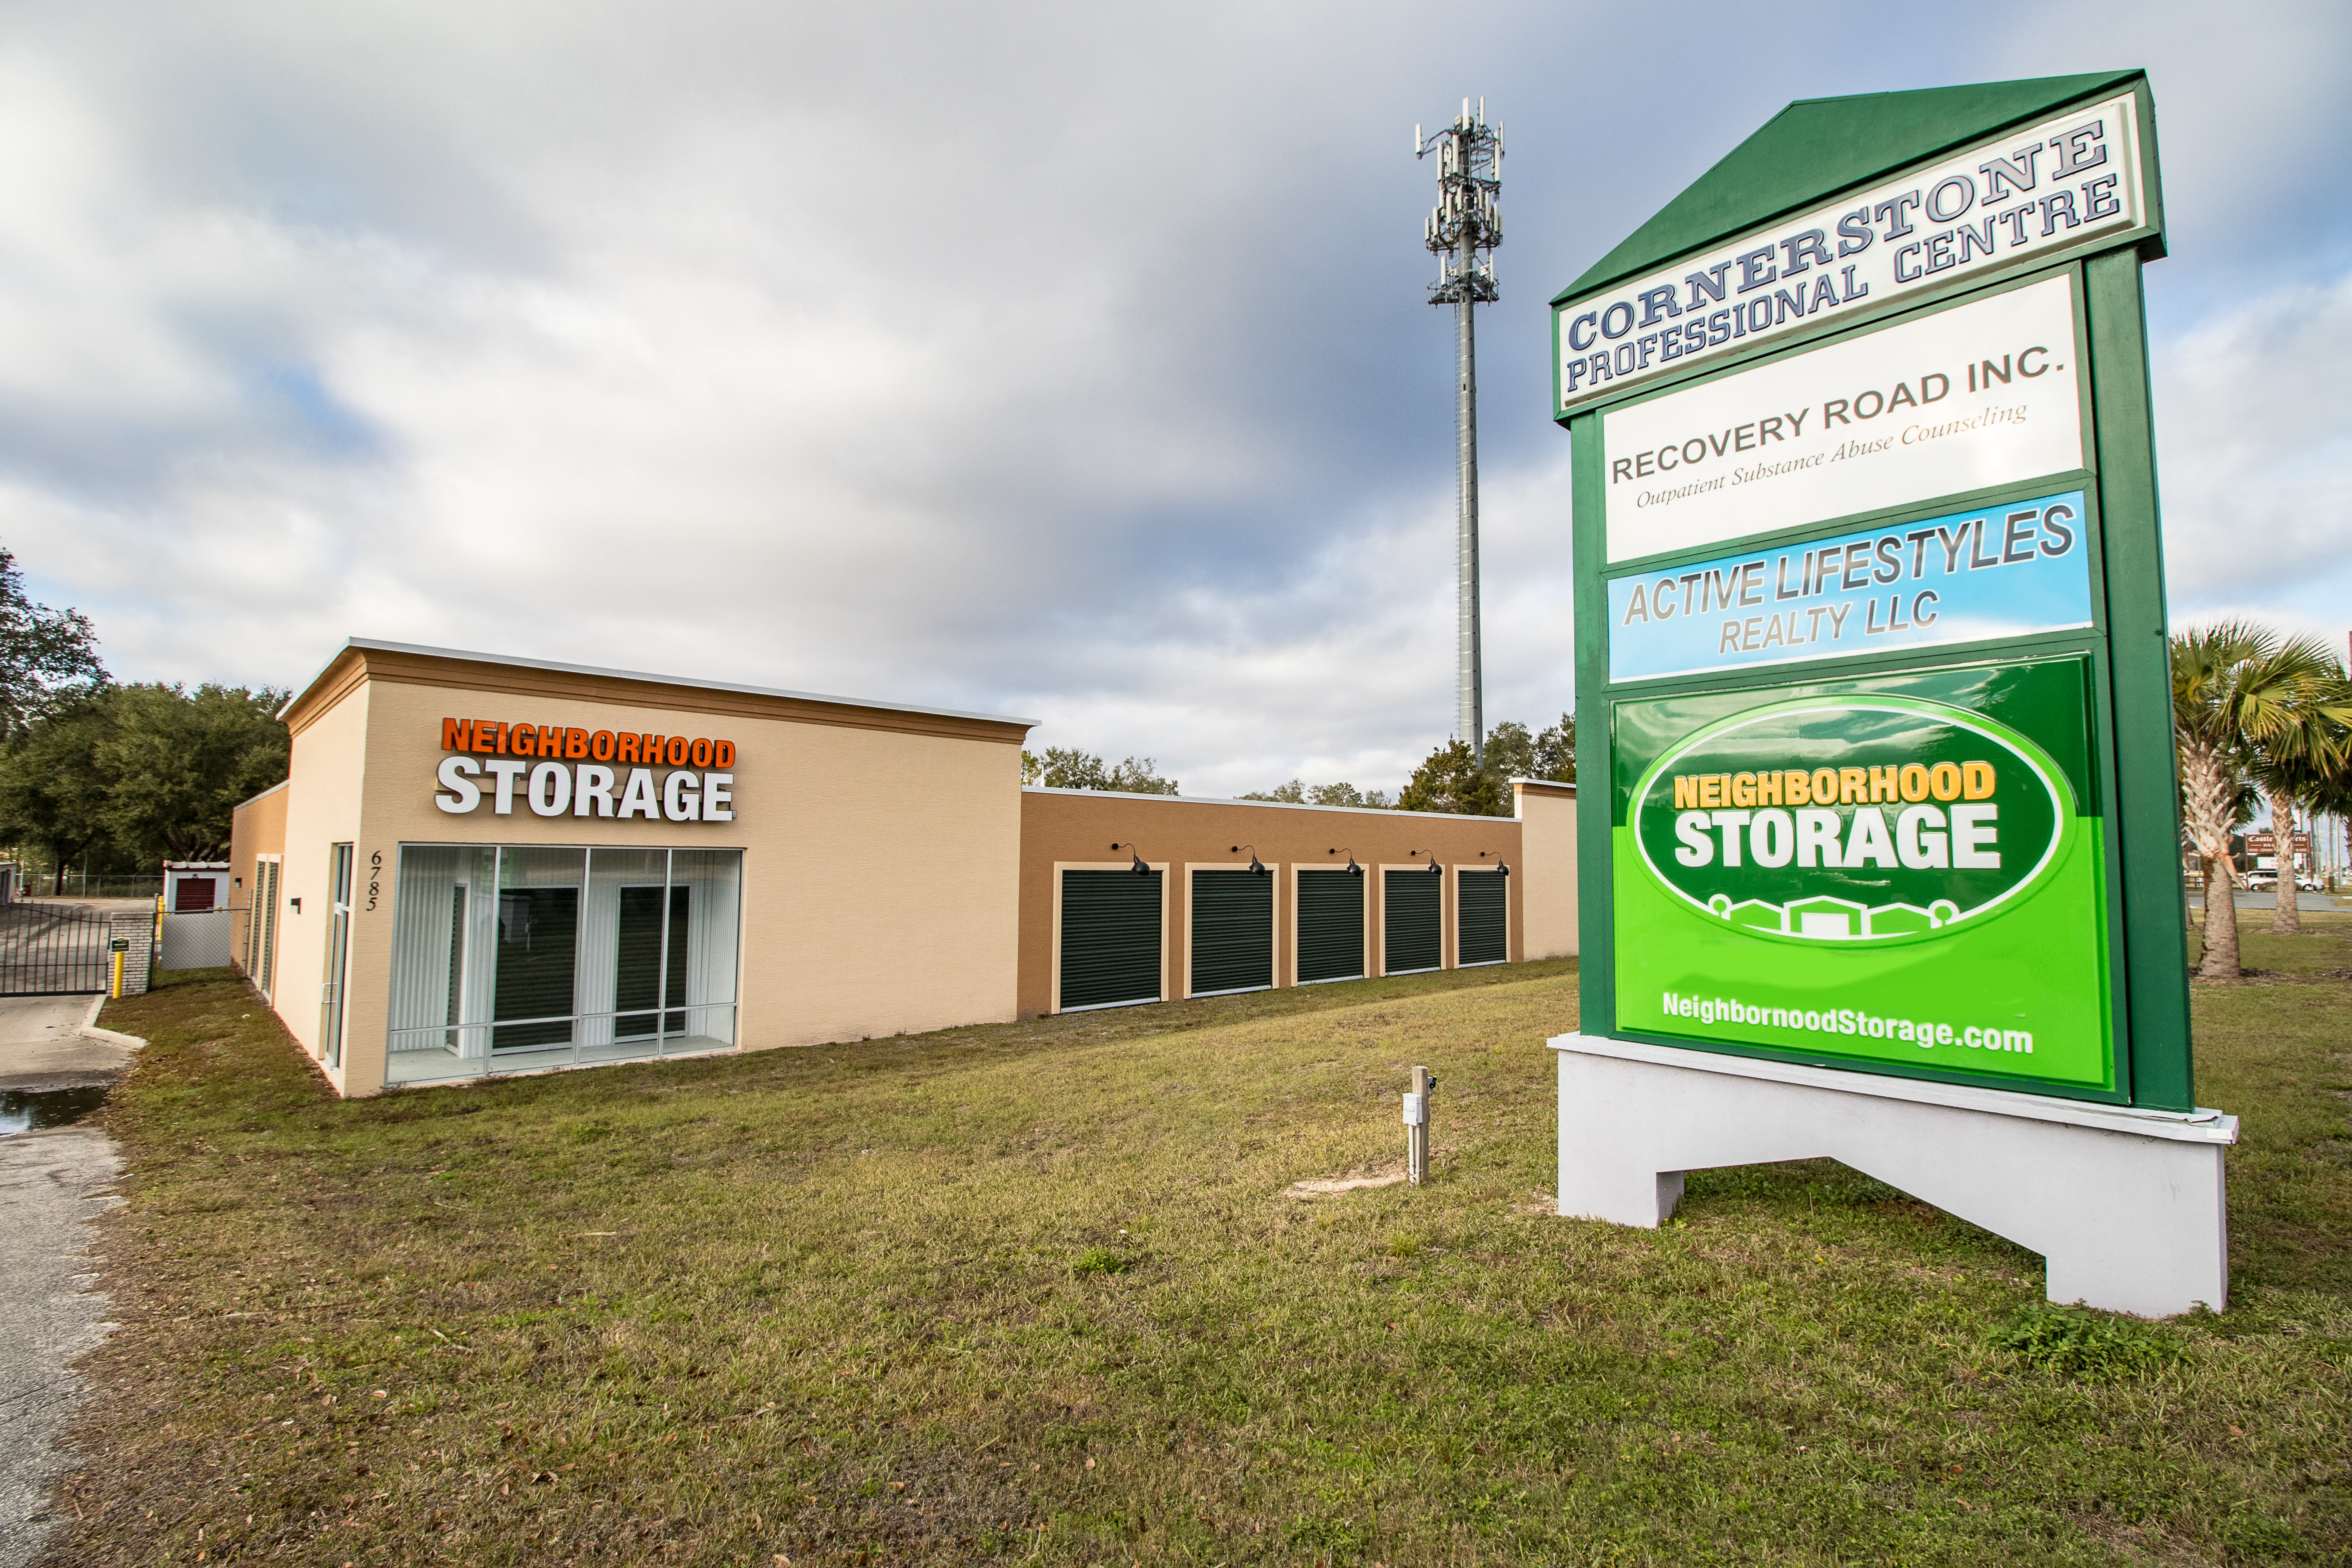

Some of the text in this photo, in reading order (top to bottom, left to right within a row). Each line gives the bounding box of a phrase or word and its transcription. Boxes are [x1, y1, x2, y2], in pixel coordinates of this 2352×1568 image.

[1567, 120, 2109, 352] CORNERSTONE
[1567, 173, 2121, 393] PROFESSIONAL CENTRE
[1613, 346, 2065, 484] RECOVERY ROAD INC.
[1636, 402, 2029, 509] Outpatient Substance Abuse Counseling
[1623, 504, 2076, 626] ACTIVE LIFESTYLES
[1719, 589, 1941, 654] REALTY LLC
[442, 718, 735, 767] NEIGHBORHOOD
[435, 756, 734, 822] STORAGE
[1673, 761, 1996, 809] NEIGHBORHOOD
[1675, 804, 2001, 870] STORAGE
[366, 850, 382, 911] 6785
